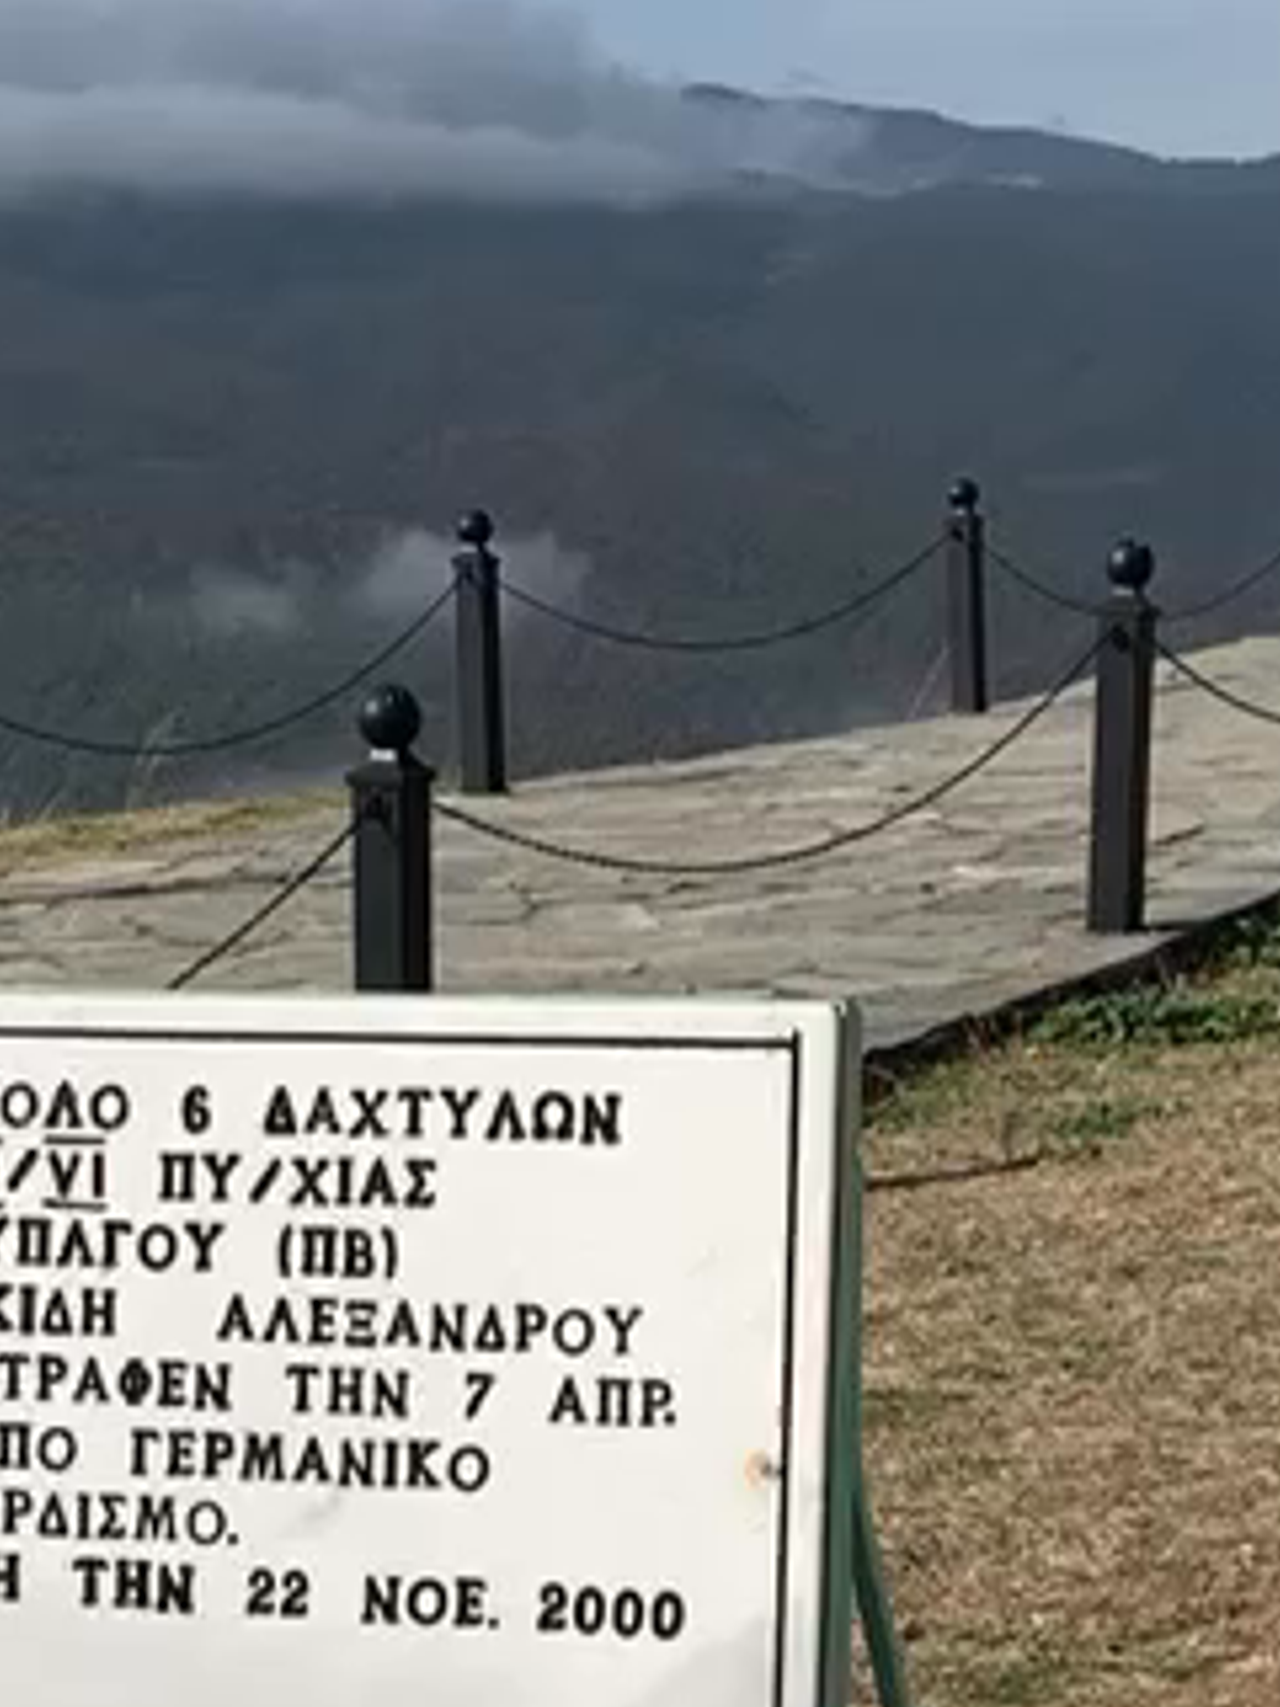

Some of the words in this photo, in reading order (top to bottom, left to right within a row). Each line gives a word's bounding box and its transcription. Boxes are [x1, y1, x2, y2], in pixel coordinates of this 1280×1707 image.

[181, 1085, 211, 1135] 6
[263, 1085, 621, 1146] ΔΑΧΤΥΛΩΝ
[159, 1152, 437, 1209] ΠΥ/ΧΙΑΣ
[278, 1224, 398, 1280] (ΠΒ)
[216, 1293, 642, 1357] ΑΛΕΞΑΝΔΡΟΥ
[285, 1363, 410, 1419] ΤΗΝ
[465, 1372, 495, 1420] 7
[549, 1376, 676, 1427] ΑΠΡ.
[130, 1428, 490, 1493] ΓΕΡΜΑΝΙΚΟ
[72, 1556, 195, 1615] ΤΗΝ
[246, 1567, 309, 1618] 22
[361, 1575, 499, 1629] ΝΟΕ.
[536, 1582, 685, 1641] 2000
